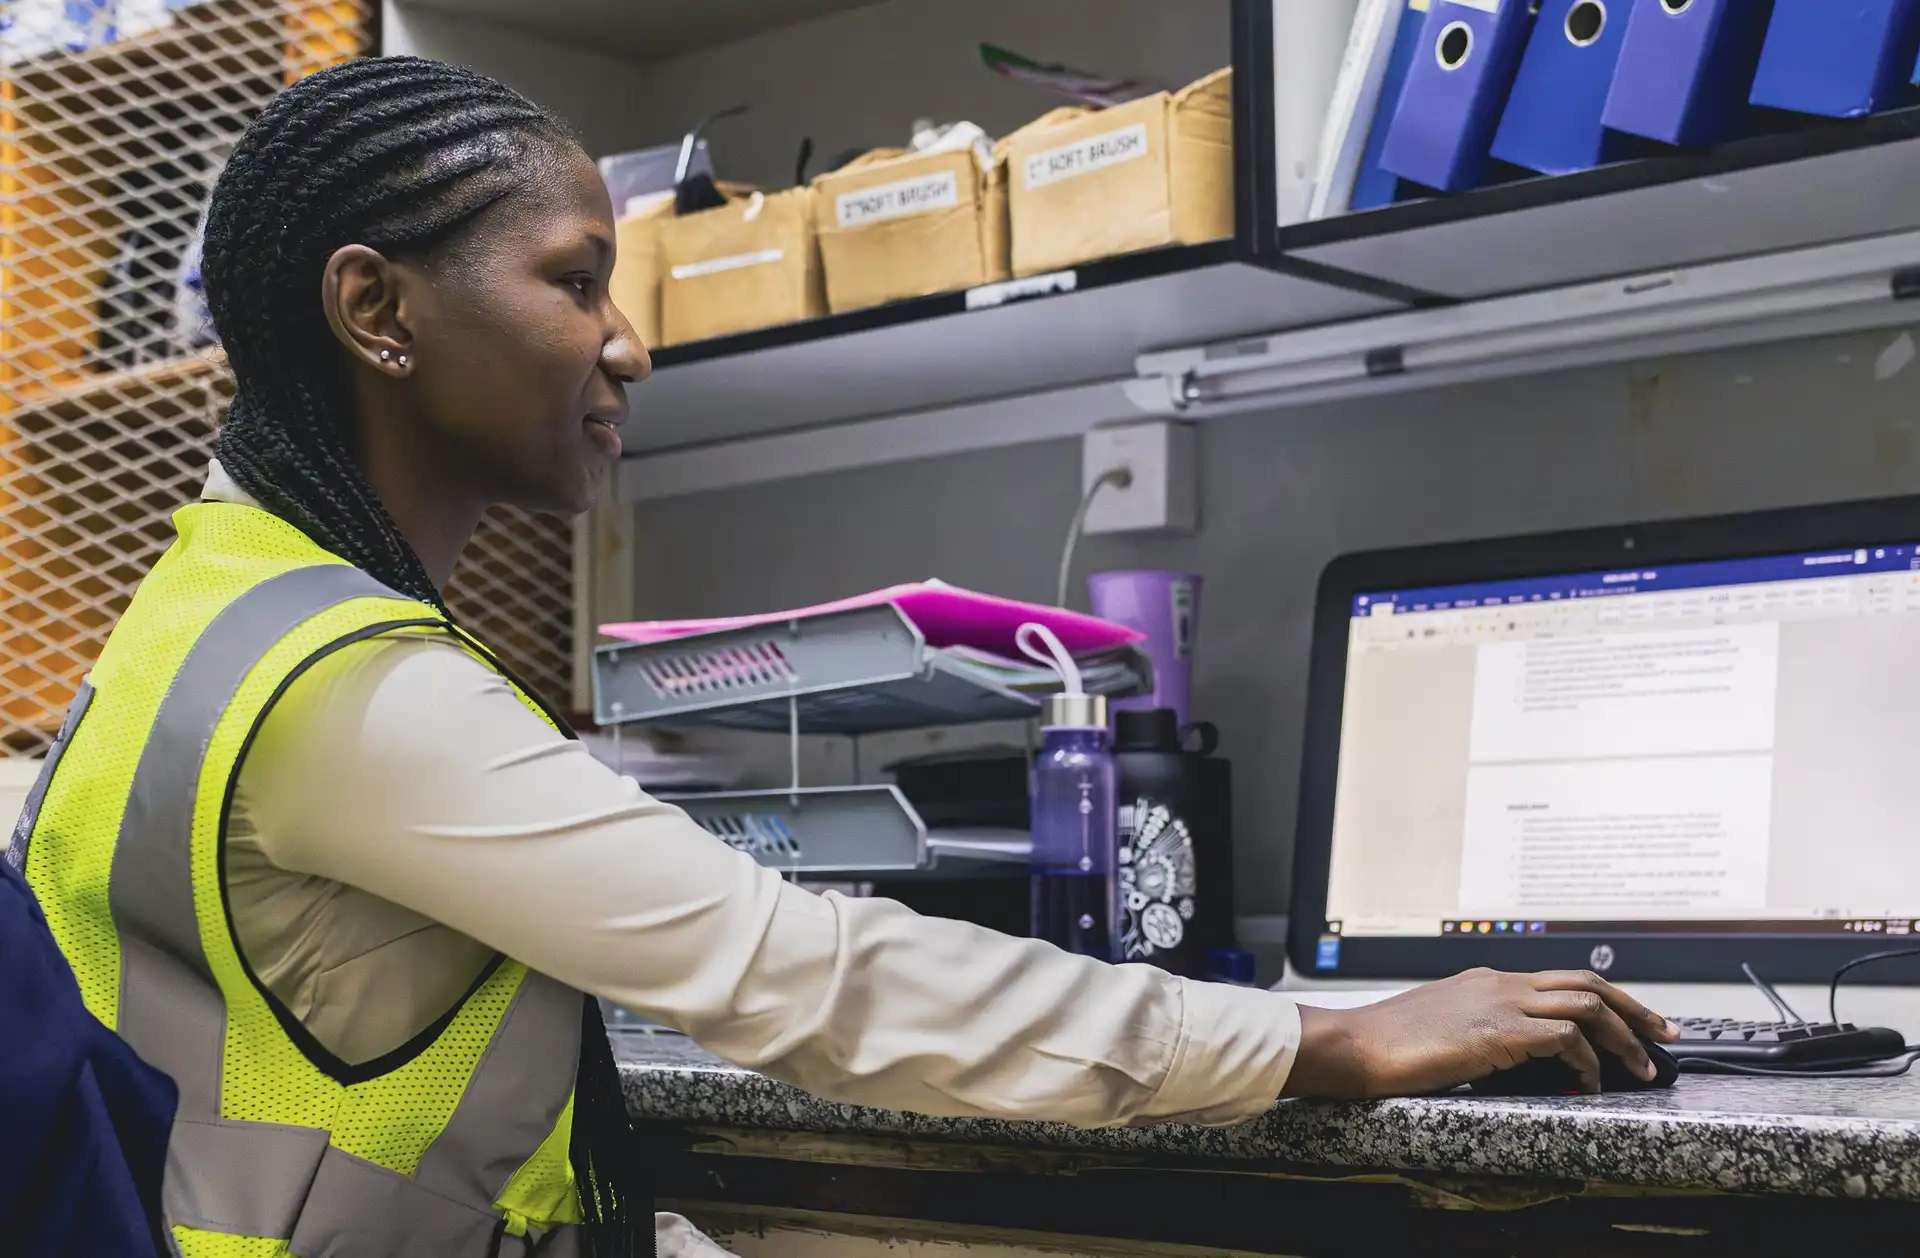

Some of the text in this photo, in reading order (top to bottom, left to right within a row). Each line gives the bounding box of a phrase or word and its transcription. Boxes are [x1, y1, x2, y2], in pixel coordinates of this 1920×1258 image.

[1048, 147, 1083, 173] SOFT
[1089, 134, 1138, 162] BRUSH
[898, 181, 949, 206] BRUSH
